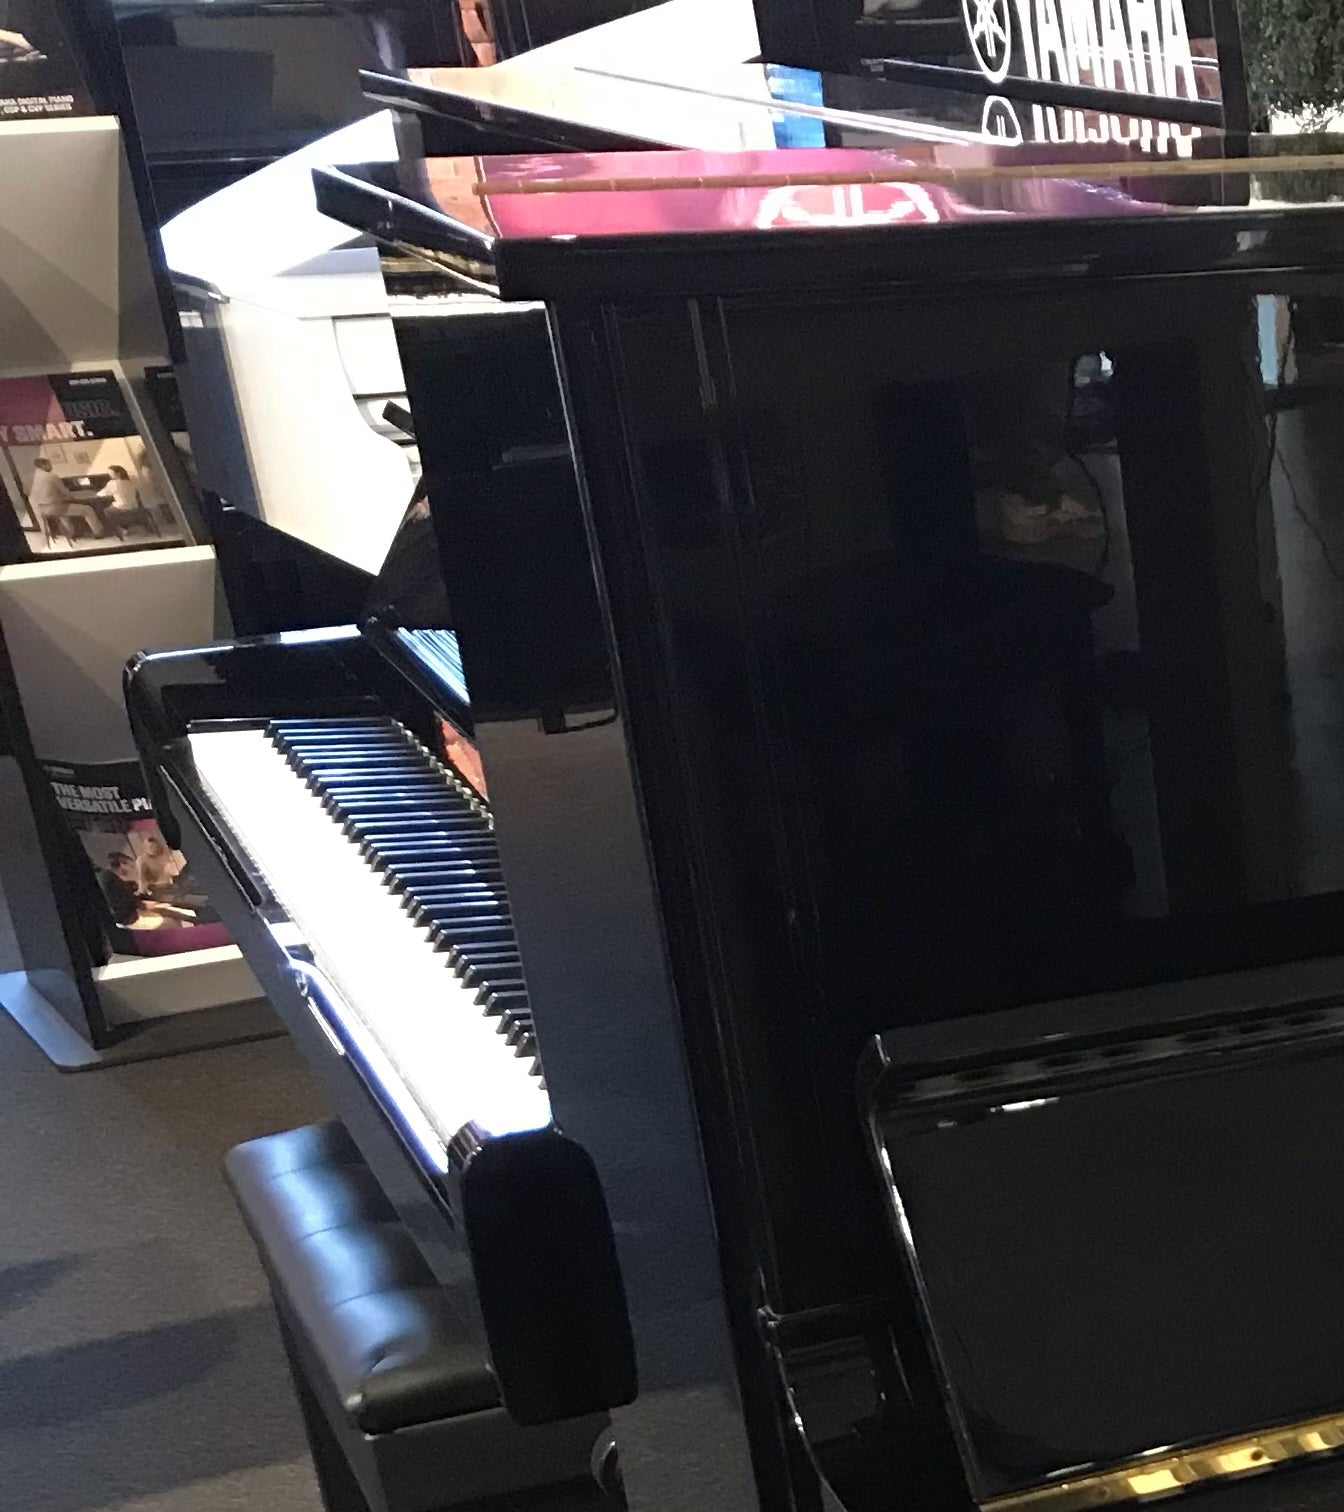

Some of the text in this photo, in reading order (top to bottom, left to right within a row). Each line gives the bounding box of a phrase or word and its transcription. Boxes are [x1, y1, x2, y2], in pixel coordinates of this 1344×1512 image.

[12, 420, 94, 442] SMART.
[50, 782, 120, 800] THE MOST
[56, 796, 132, 813] VERSATILE
